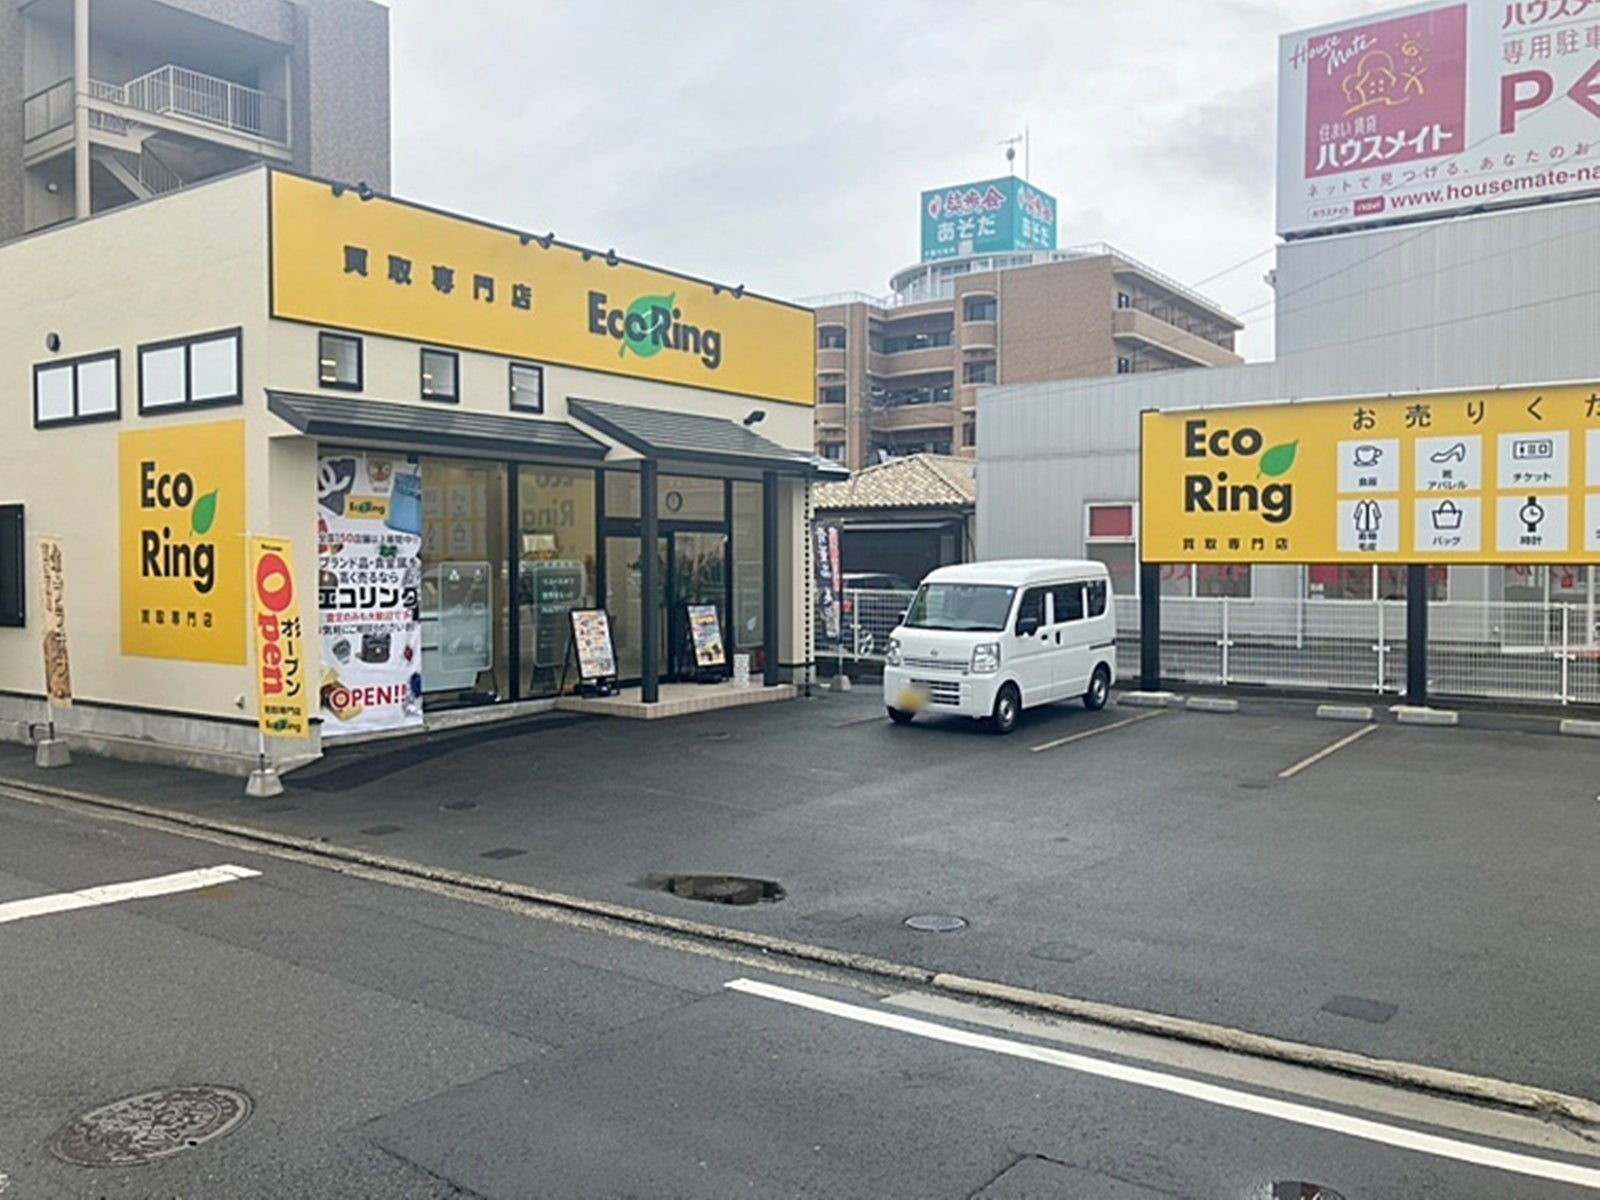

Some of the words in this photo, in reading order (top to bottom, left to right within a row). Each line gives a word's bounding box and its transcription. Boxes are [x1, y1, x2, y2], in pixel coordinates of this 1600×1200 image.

[1502, 0, 1600, 29] ハウスメ
[1288, 35, 1342, 69] House
[1327, 33, 1378, 75] Mate
[1500, 69, 1554, 134] P
[1315, 123, 1453, 171] ハウスメイト
[1390, 164, 1600, 208] www.housemate-na
[343, 244, 532, 311] 買取専門店
[587, 290, 721, 370] EcoRing
[1184, 419, 1263, 458] Eco
[141, 461, 194, 508] Eco
[1184, 471, 1293, 524] Ring
[1512, 471, 1552, 483] チケット
[141, 526, 215, 594] Ring
[1182, 537, 1289, 551] 買取専門店
[1432, 536, 1462, 547] バッグ
[1520, 535, 1542, 546] 時計
[141, 609, 213, 628] 買取専門店
